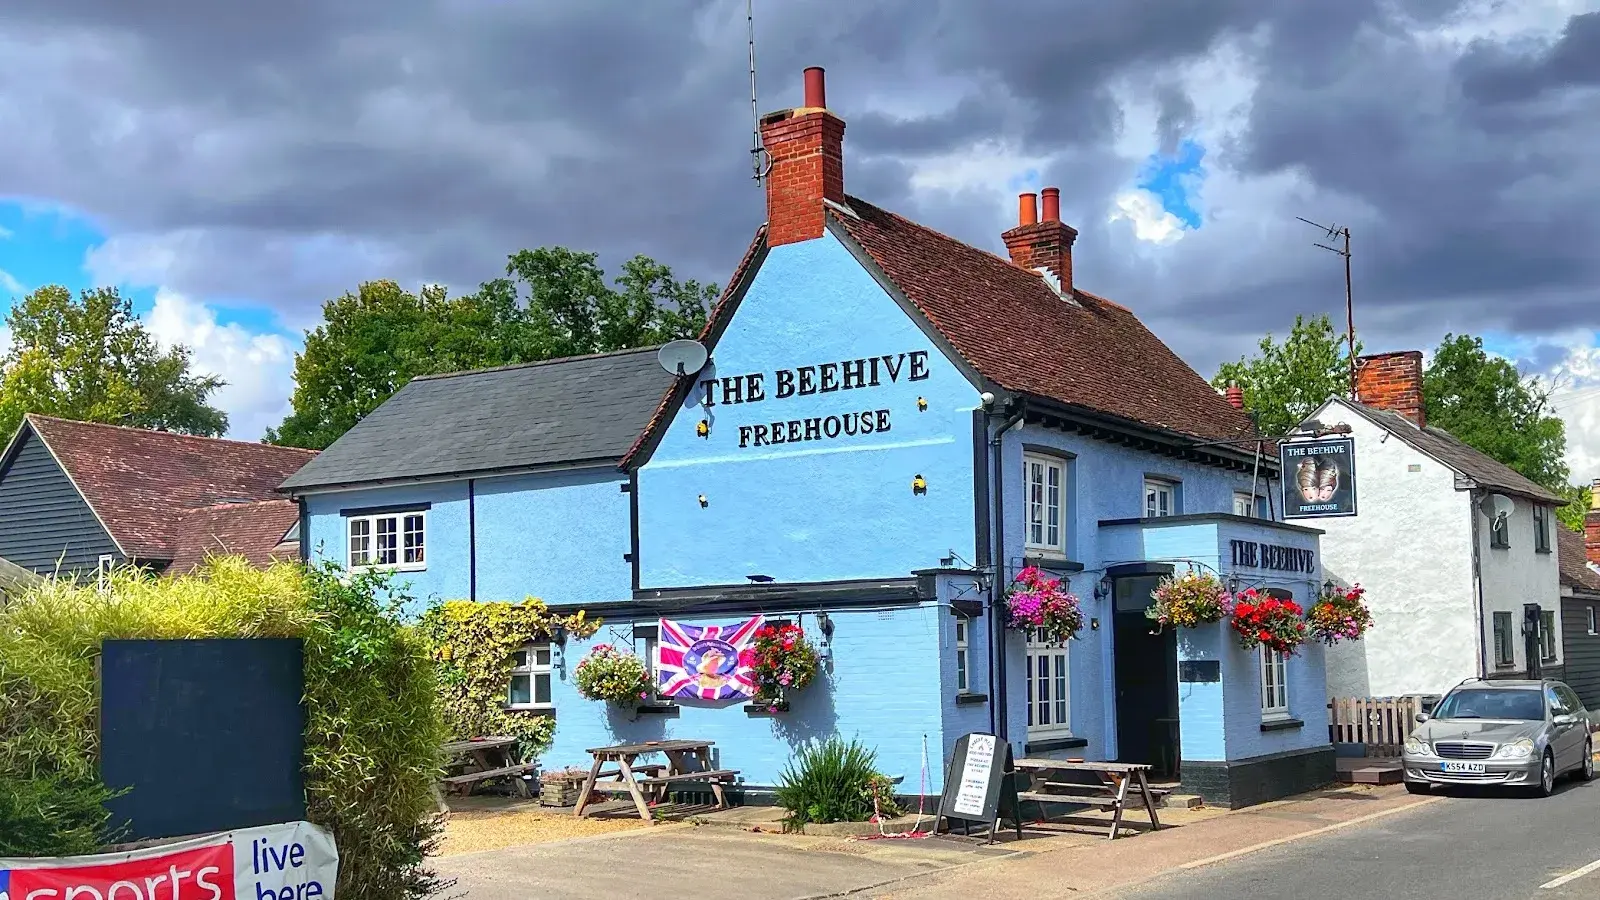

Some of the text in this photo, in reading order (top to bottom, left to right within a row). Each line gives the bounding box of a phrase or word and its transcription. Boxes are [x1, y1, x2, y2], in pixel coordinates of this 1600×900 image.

[700, 350, 930, 407] THE BEEHIVE
[738, 409, 892, 448] FREEHOUSE
[1288, 445, 1345, 457] THE BEEHIVE
[1299, 503, 1338, 513] FREEHOUSE
[1230, 539, 1315, 574] THE BEEHIVE
[1446, 762, 1484, 771] KS54 AZD
[253, 837, 305, 875] live
[26, 864, 222, 900] orts
